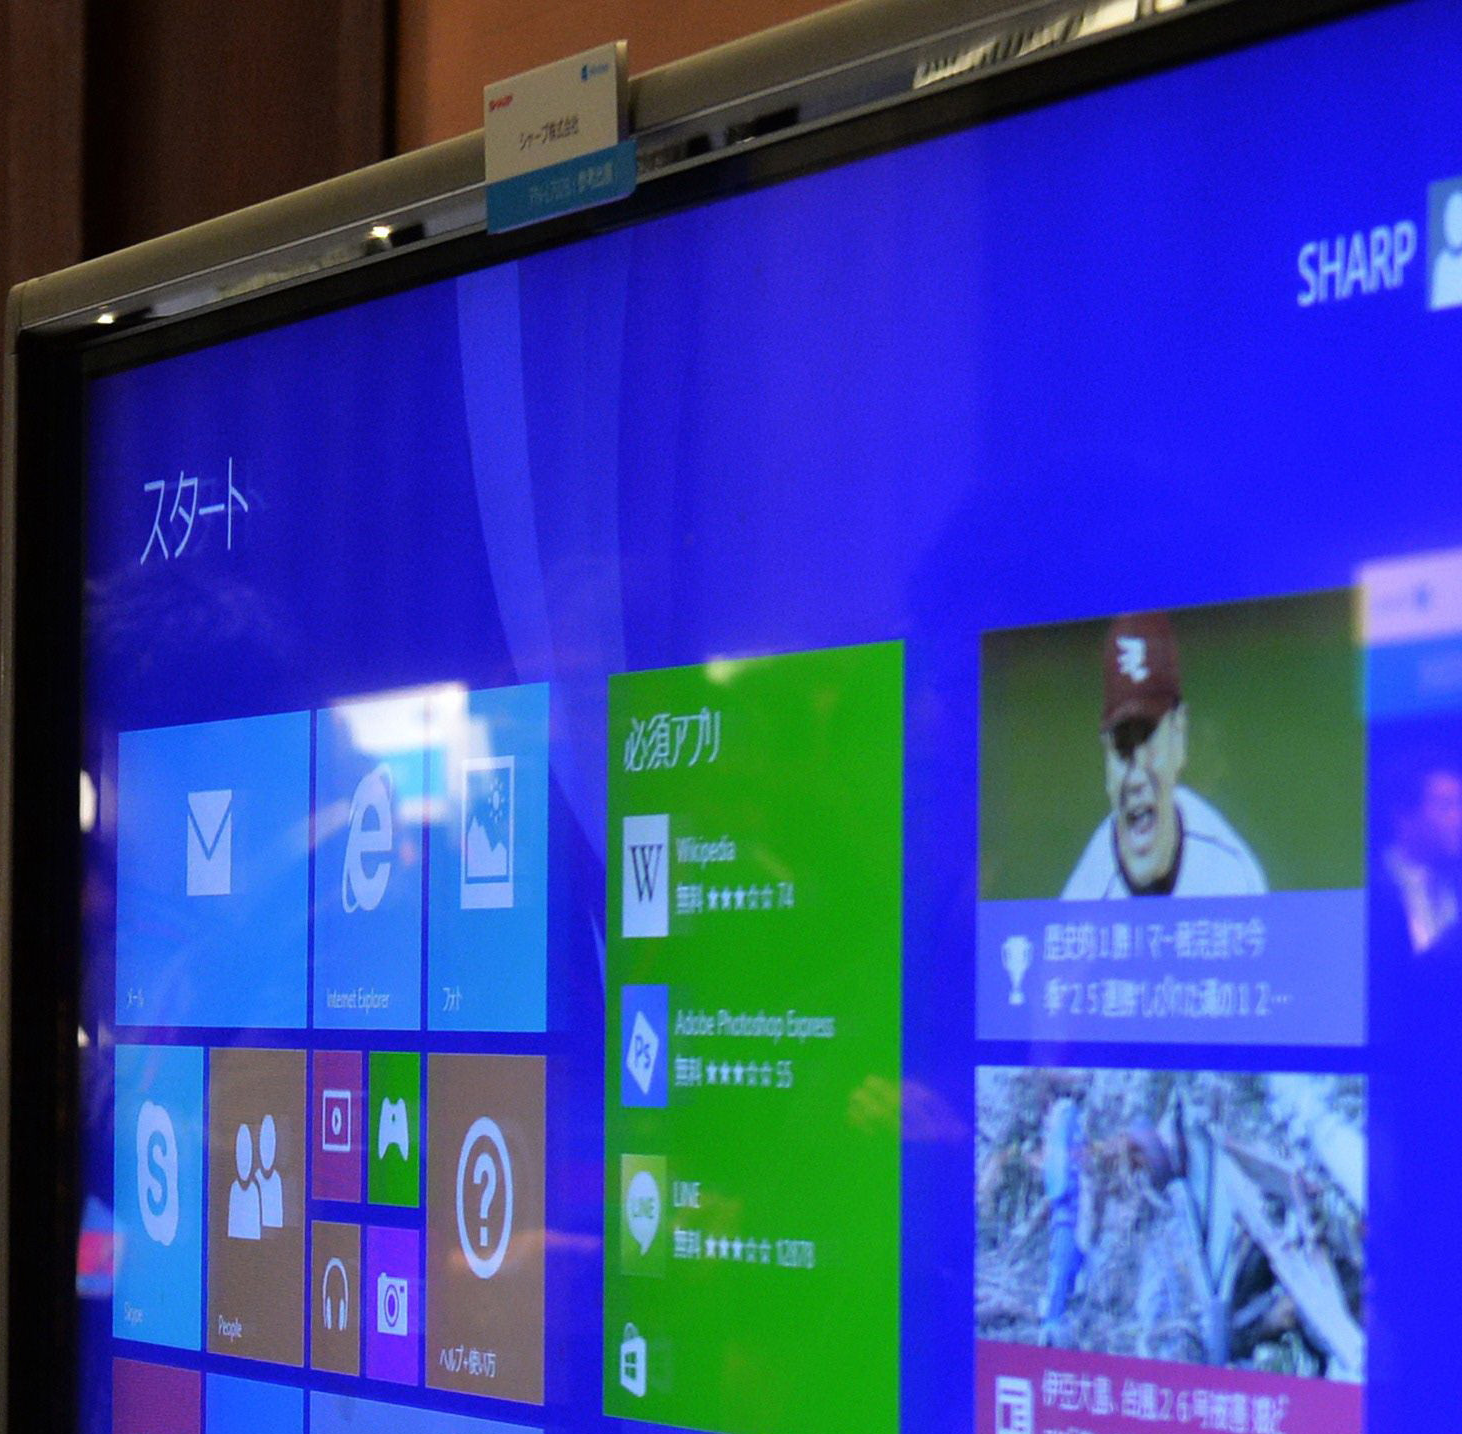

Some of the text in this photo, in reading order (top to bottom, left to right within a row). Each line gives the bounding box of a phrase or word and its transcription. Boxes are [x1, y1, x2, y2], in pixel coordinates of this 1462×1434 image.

[1297, 219, 1417, 308] SHARP
[140, 457, 249, 565] スタート
[624, 706, 722, 772] 必須アプリ
[326, 988, 390, 1014] Internet Explorer
[675, 1009, 835, 1043] Adobe Photoshop Express
[218, 1315, 243, 1344] People
